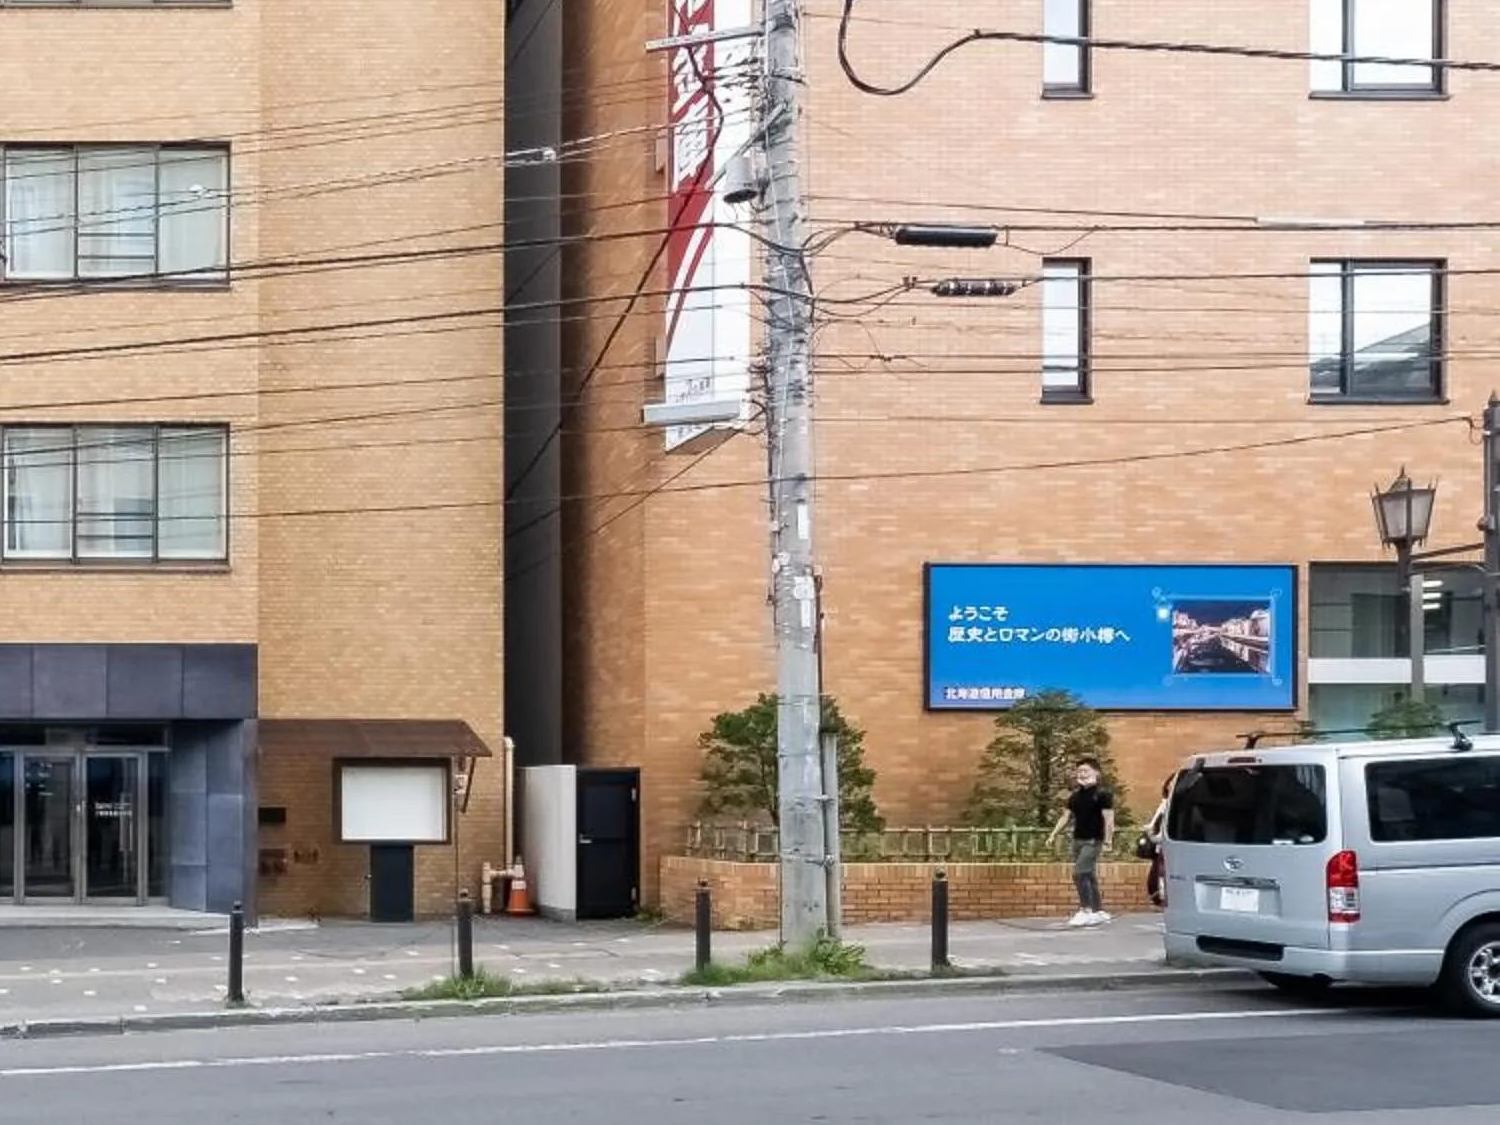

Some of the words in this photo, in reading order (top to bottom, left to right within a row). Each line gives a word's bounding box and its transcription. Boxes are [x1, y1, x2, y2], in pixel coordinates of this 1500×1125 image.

[948, 605, 1009, 622] ようこそ
[948, 626, 1131, 643] 歴史とロマンの街小樽へ
